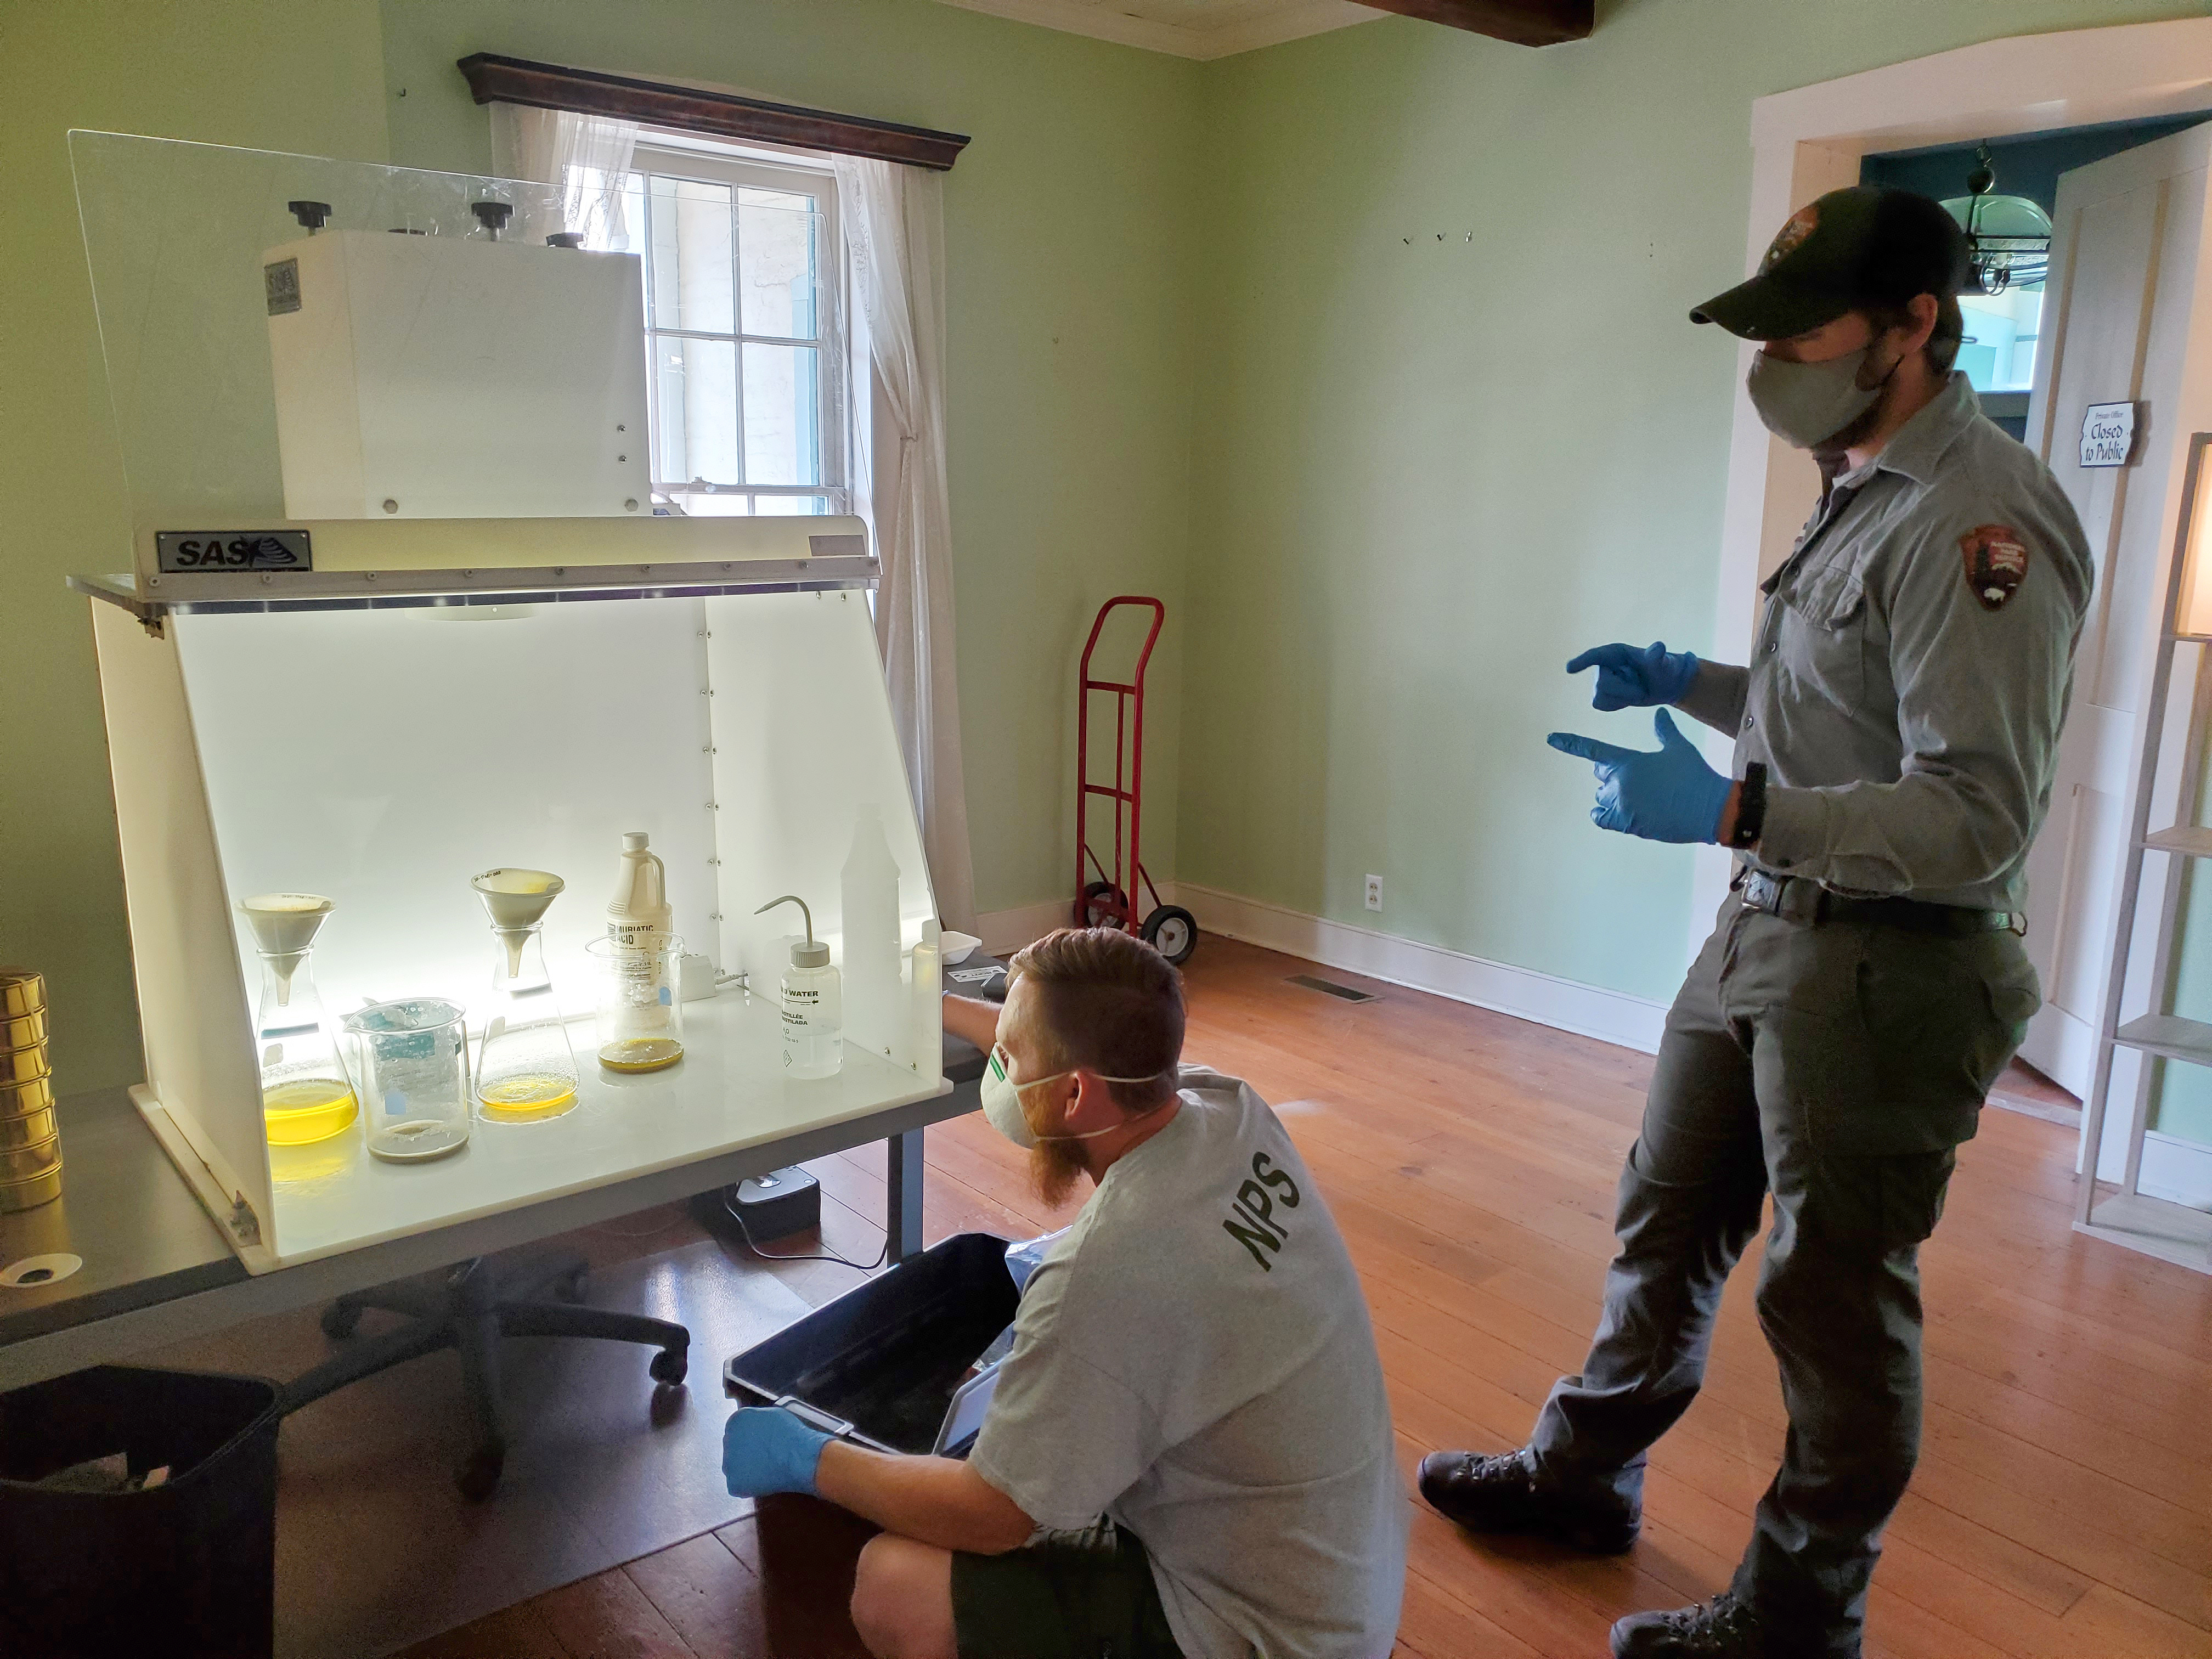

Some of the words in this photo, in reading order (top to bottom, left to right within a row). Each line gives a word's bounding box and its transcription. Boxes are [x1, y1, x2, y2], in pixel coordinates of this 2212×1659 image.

[2091, 422, 2123, 439] Closed
[2086, 447, 2094, 461] to
[2096, 441, 2124, 461] Public
[617, 934, 634, 945] ACID
[1222, 1152, 1300, 1272] NPS
